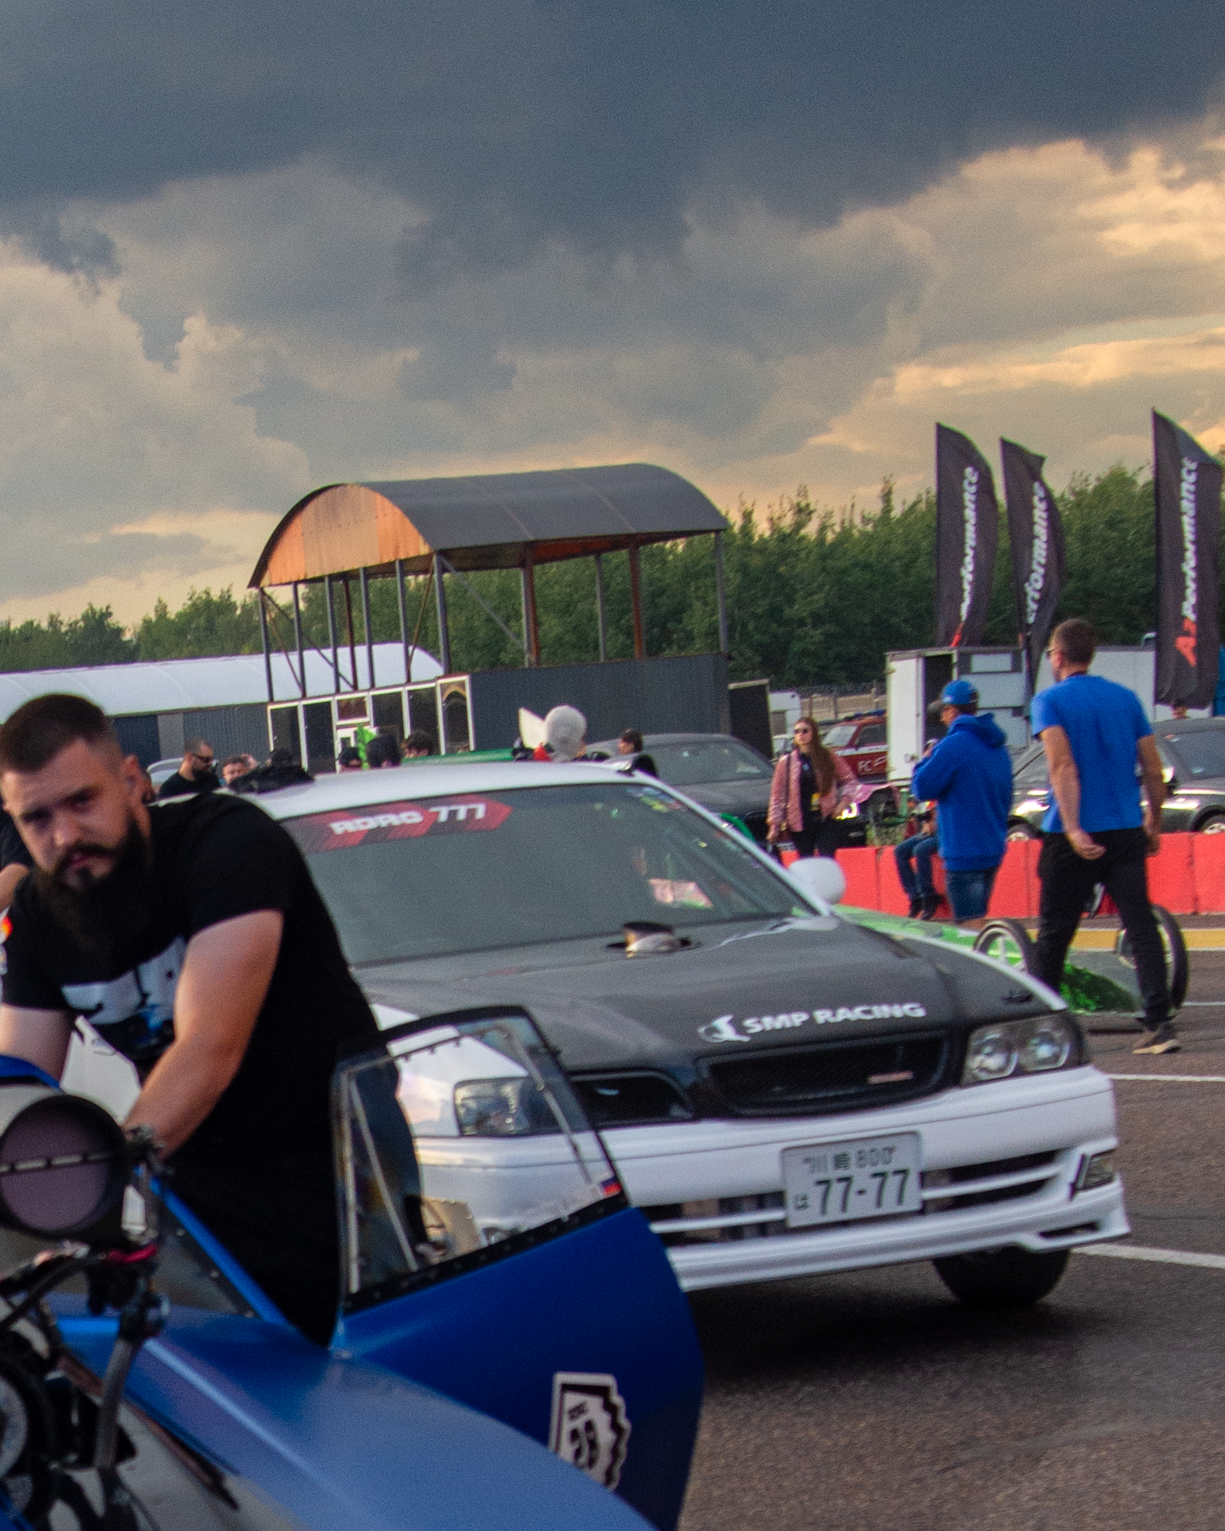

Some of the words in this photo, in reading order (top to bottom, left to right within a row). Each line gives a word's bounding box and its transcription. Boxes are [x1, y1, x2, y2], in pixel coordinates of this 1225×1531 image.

[428, 802, 486, 823] 777
[742, 1011, 810, 1035] SMP
[813, 1002, 926, 1024] RACING
[815, 1168, 910, 1216] 77-77
